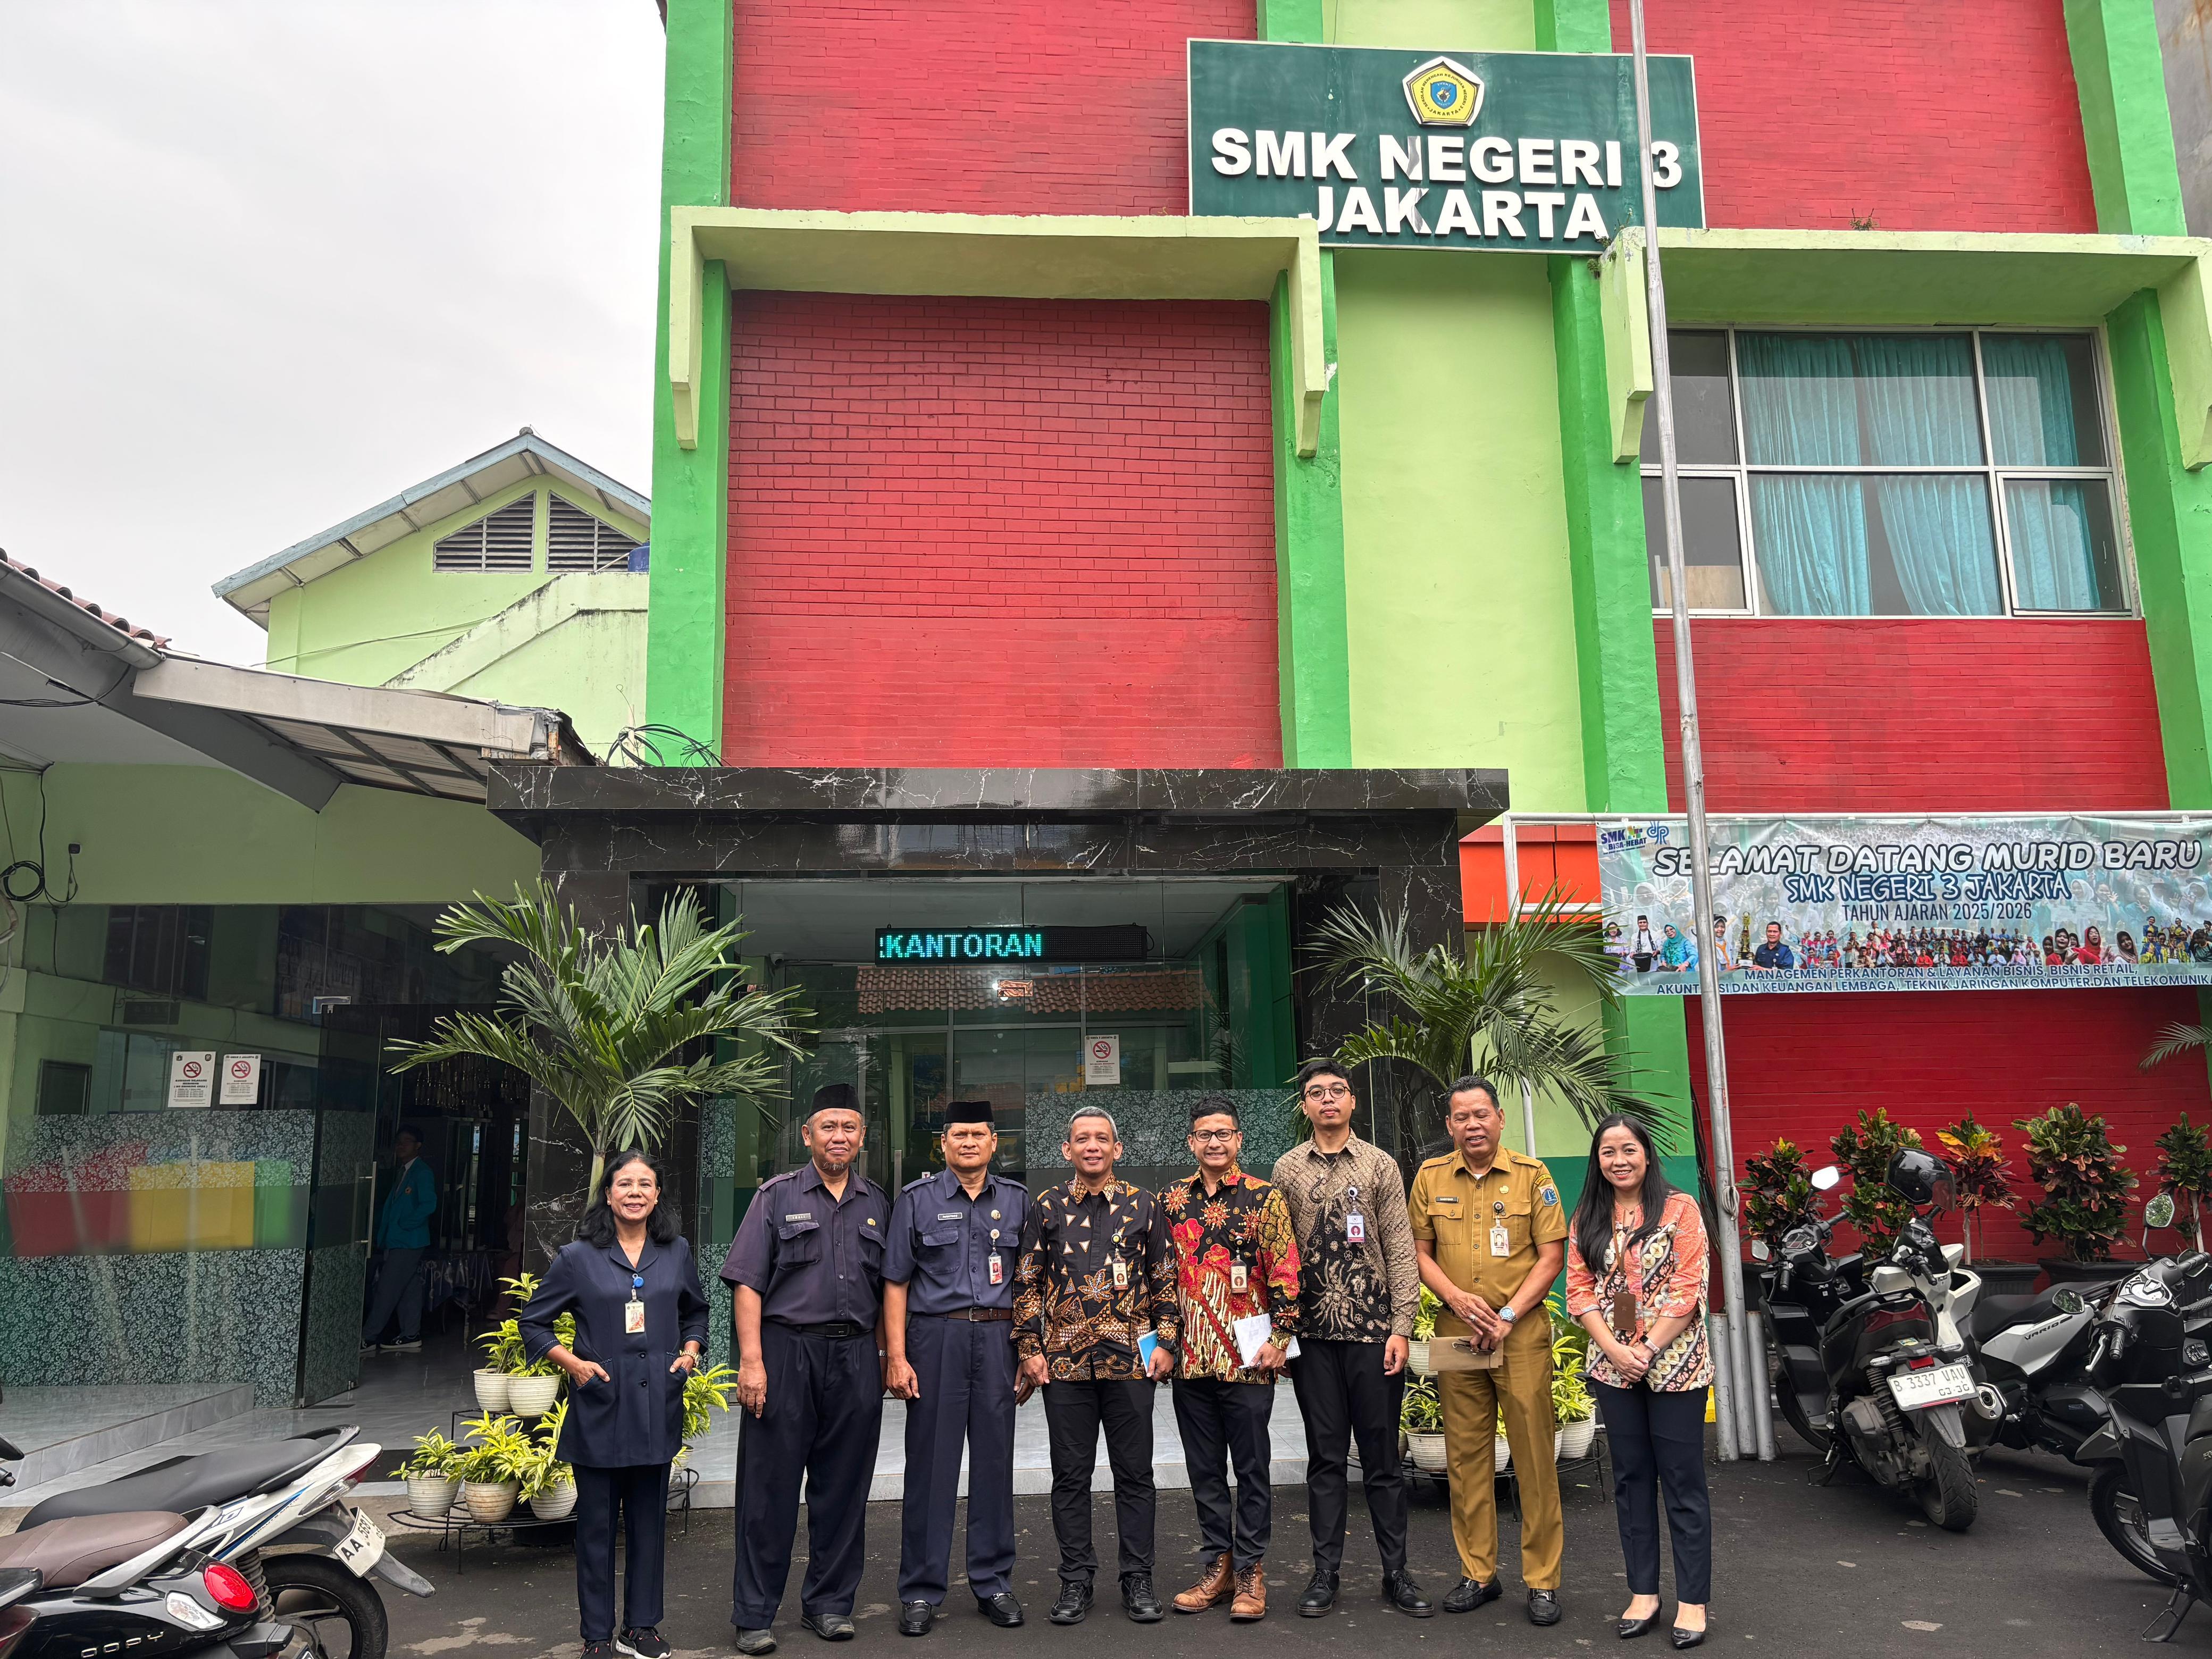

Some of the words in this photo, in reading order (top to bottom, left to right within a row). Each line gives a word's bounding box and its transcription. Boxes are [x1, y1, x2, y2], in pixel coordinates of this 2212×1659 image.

[1211, 128, 1358, 180] SMK
[1379, 134, 1622, 188] NEGERI
[1650, 141, 1682, 187] 3
[1298, 186, 1608, 240] JAKARTA
[1601, 829, 1626, 844] SMK
[1608, 837, 1647, 850] BISA-HEBAT
[1827, 843, 1973, 875] DATANG
[1982, 840, 2096, 872] MURID
[2102, 839, 2202, 870] BARU
[1783, 873, 1835, 903] SMK
[1838, 873, 1935, 902] NEGERI
[1942, 873, 1961, 901] 3
[1966, 870, 2073, 901] JAKARTA
[1842, 904, 1889, 921] TAHUN
[1895, 903, 1949, 921] AJARAN
[1953, 902, 2032, 920] 2025/2026
[880, 934, 1041, 958] KANTORAN
[1745, 969, 1826, 980] MANAGEMEN
[1831, 967, 1924, 979] PERKANTORAN
[1927, 967, 1936, 977] &
[1940, 966, 1999, 977] LAYANAN
[2004, 966, 2047, 977] BISNIS,
[2050, 965, 2090, 975] BISNIS
[2093, 964, 2138, 975] RETAIL,
[1657, 983, 1729, 994] AKUNTSI
[1732, 983, 1759, 993] DAN
[1763, 982, 1832, 992] KEUANGAN
[1836, 981, 1899, 991] LEMBAGA,
[1905, 979, 1949, 990] TEKNIK
[1953, 978, 2018, 989] JARINGAN
[2023, 977, 2091, 988] KOMPUTER
[2093, 976, 2121, 986] DAN
[2124, 975, 2212, 986] TELEKOMUNIK
[2024, 1322, 2059, 1340] VARIO
[1893, 1380, 1903, 1392] B
[1907, 1373, 1936, 1389] 3337
[341, 1538, 364, 1561] AA
